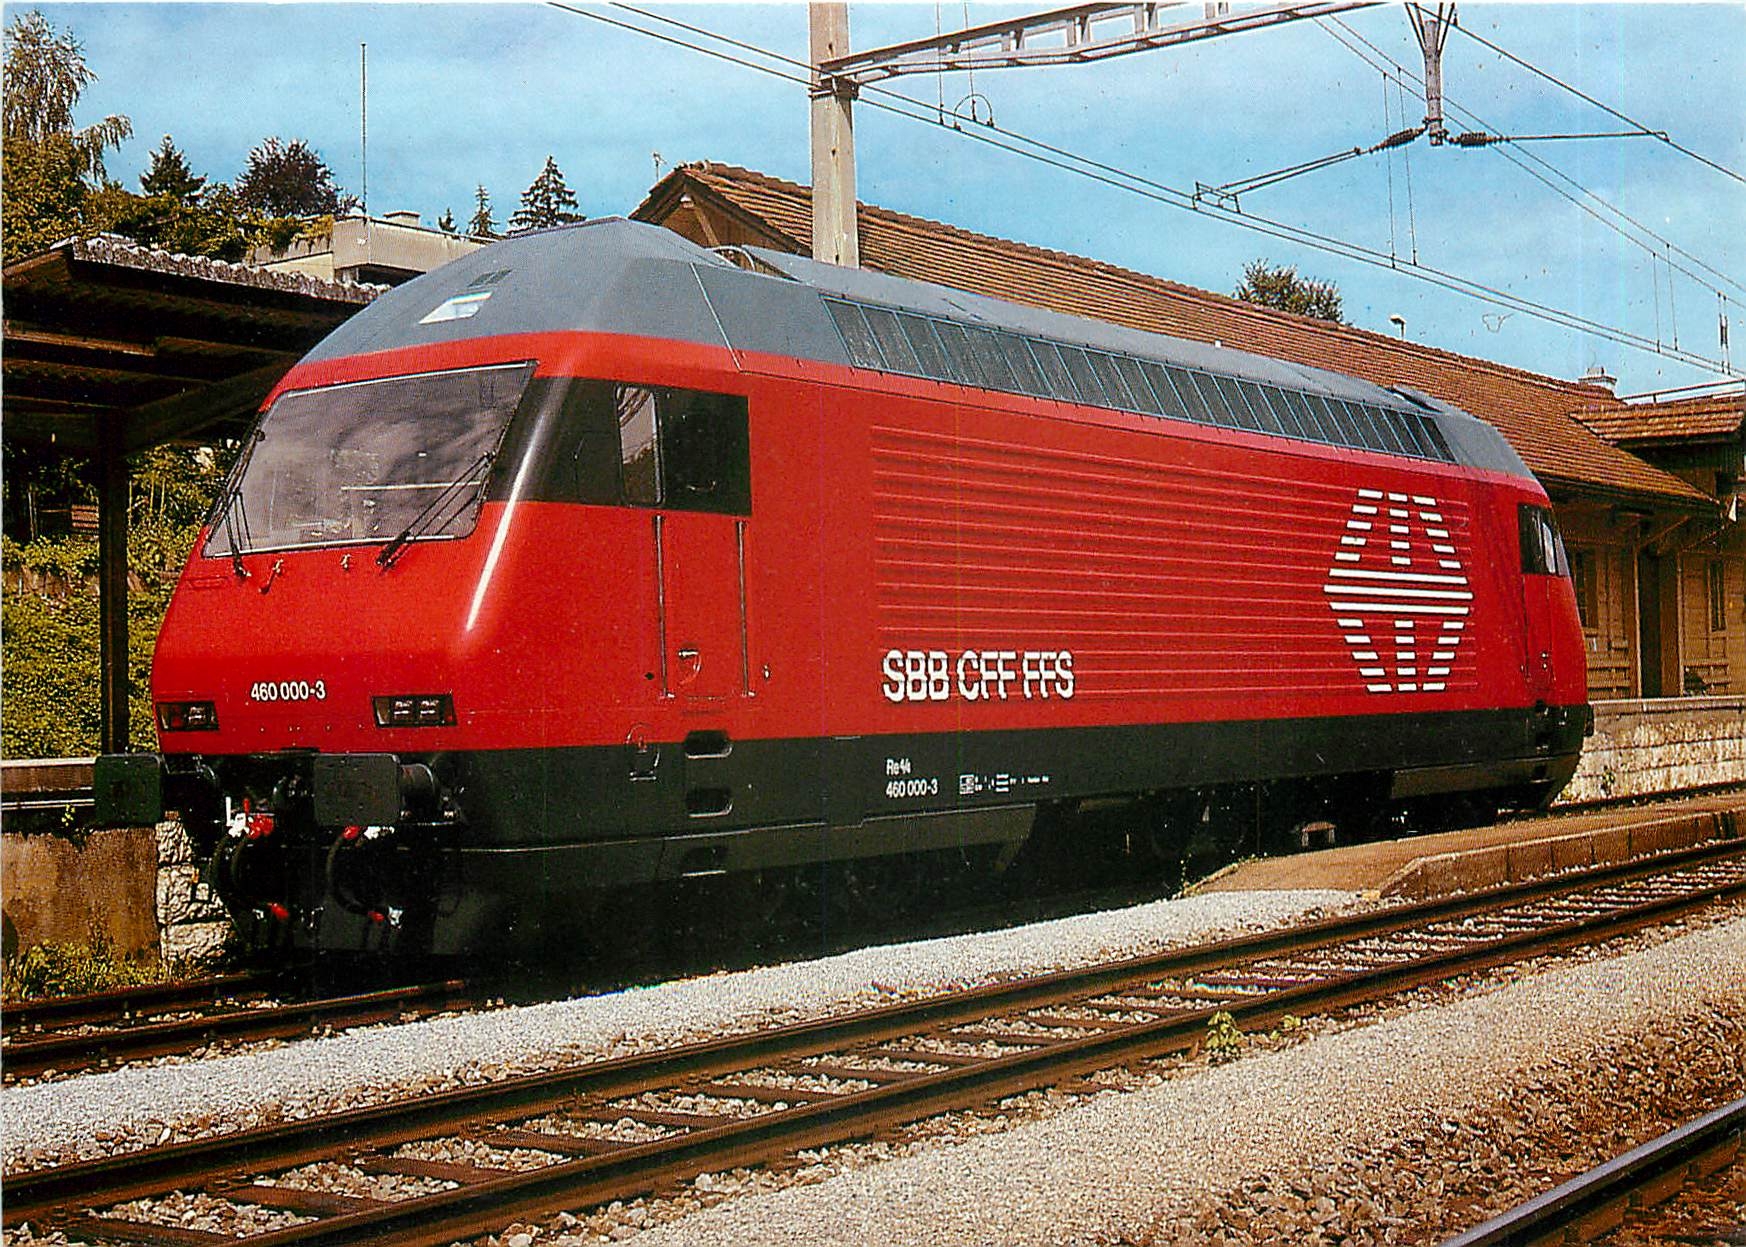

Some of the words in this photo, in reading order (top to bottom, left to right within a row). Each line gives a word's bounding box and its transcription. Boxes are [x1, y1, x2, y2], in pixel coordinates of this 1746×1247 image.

[882, 650, 951, 702] SBB
[956, 650, 1017, 700] CFF
[1022, 650, 1075, 699] FFS
[250, 681, 278, 702] 460
[280, 680, 326, 701] 000-3
[886, 780, 906, 798] 460
[907, 778, 938, 797] 000-3
